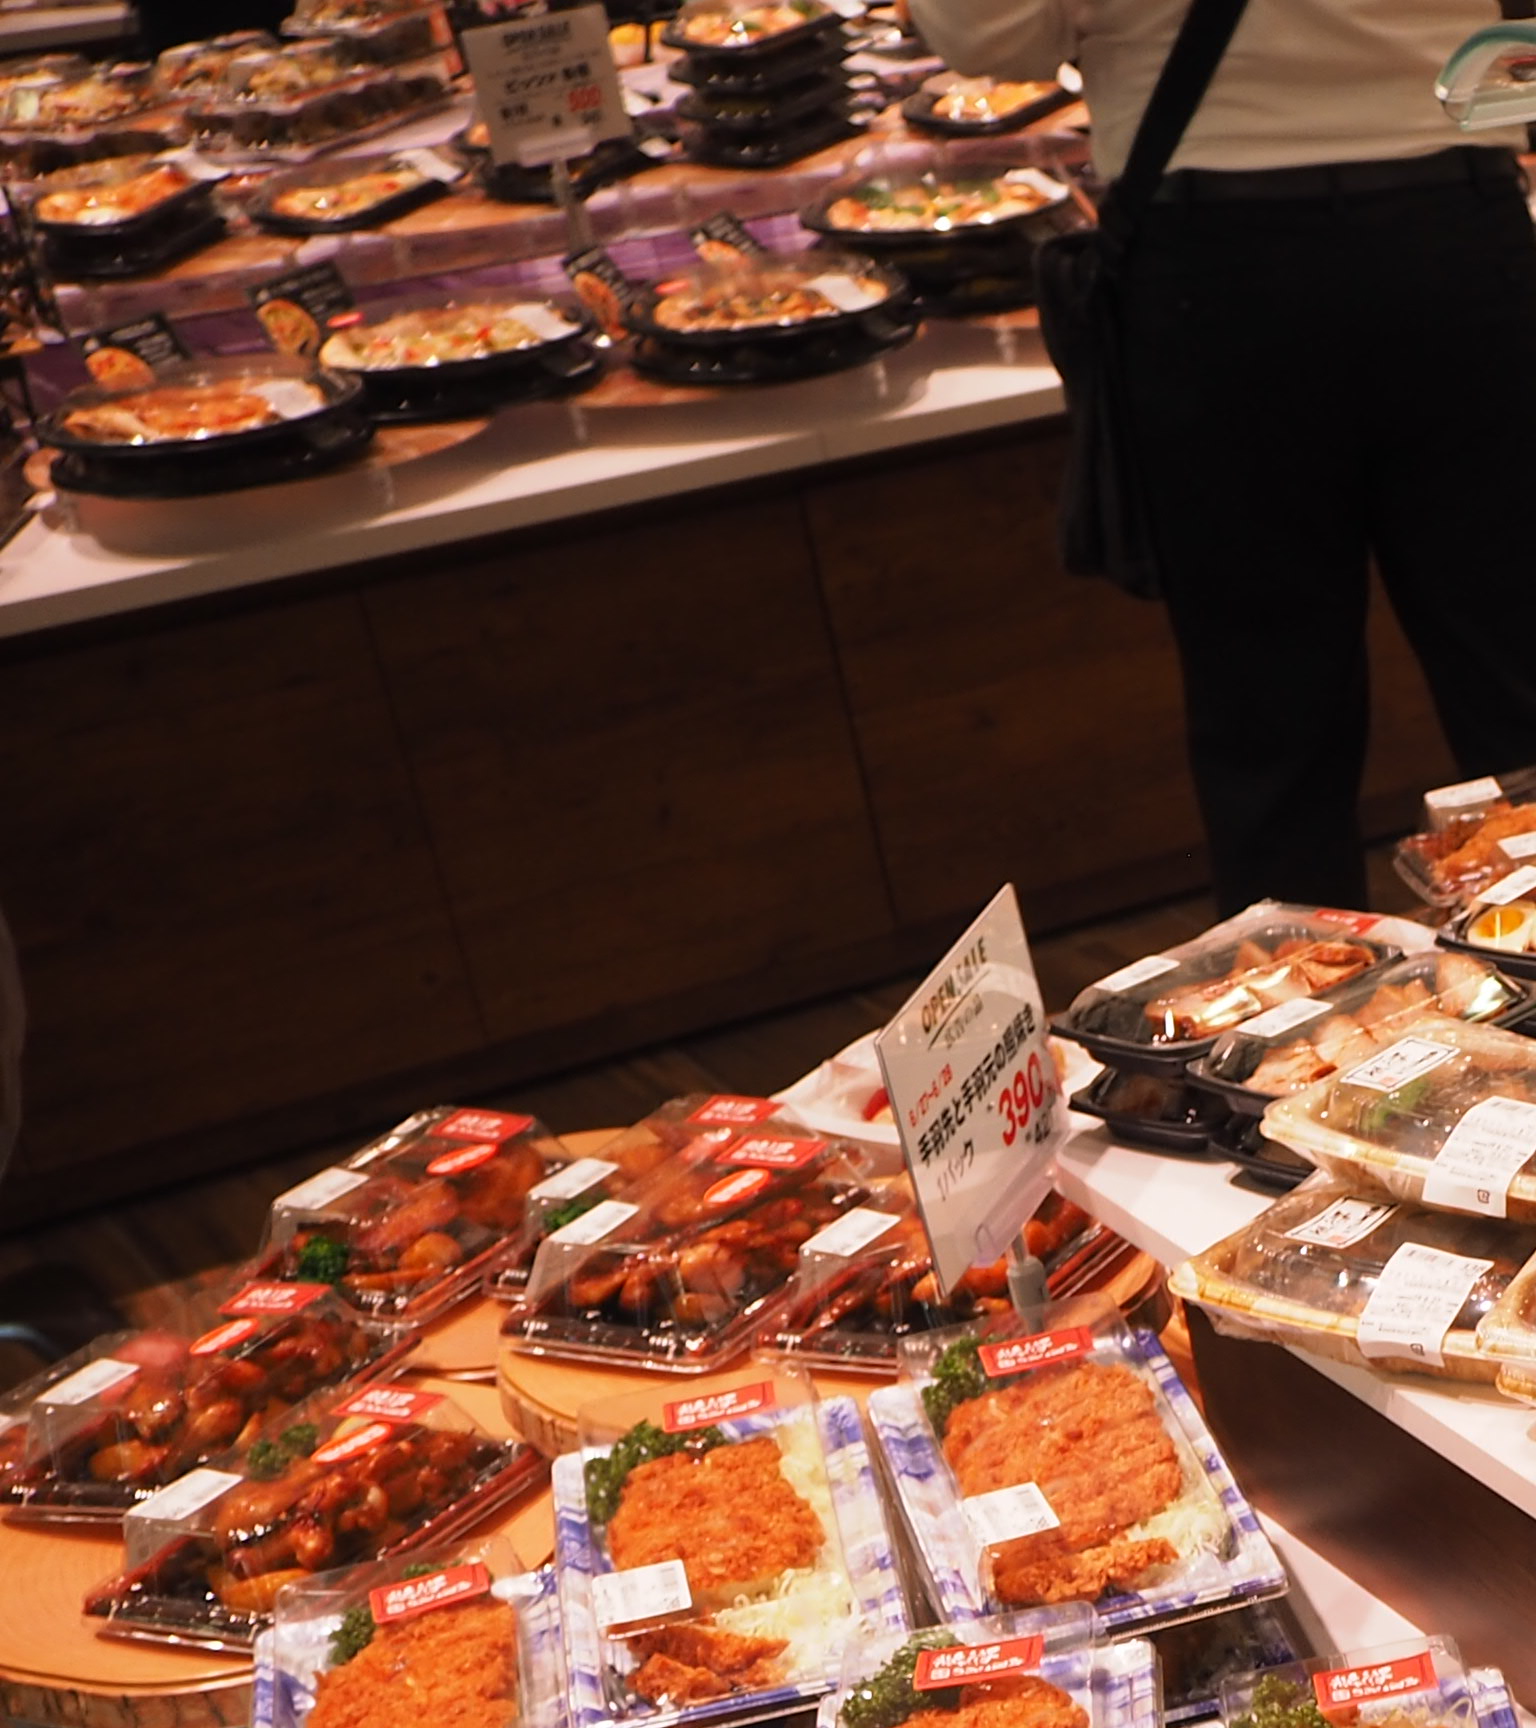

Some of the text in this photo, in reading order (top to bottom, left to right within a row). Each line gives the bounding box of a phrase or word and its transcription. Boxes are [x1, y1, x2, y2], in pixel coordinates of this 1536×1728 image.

[921, 977, 956, 1034] OPEN
[916, 1002, 1037, 1169] 手羽先と手羽元の照焼き
[998, 1051, 1046, 1149] 390
[935, 1139, 976, 1202] 1パック
